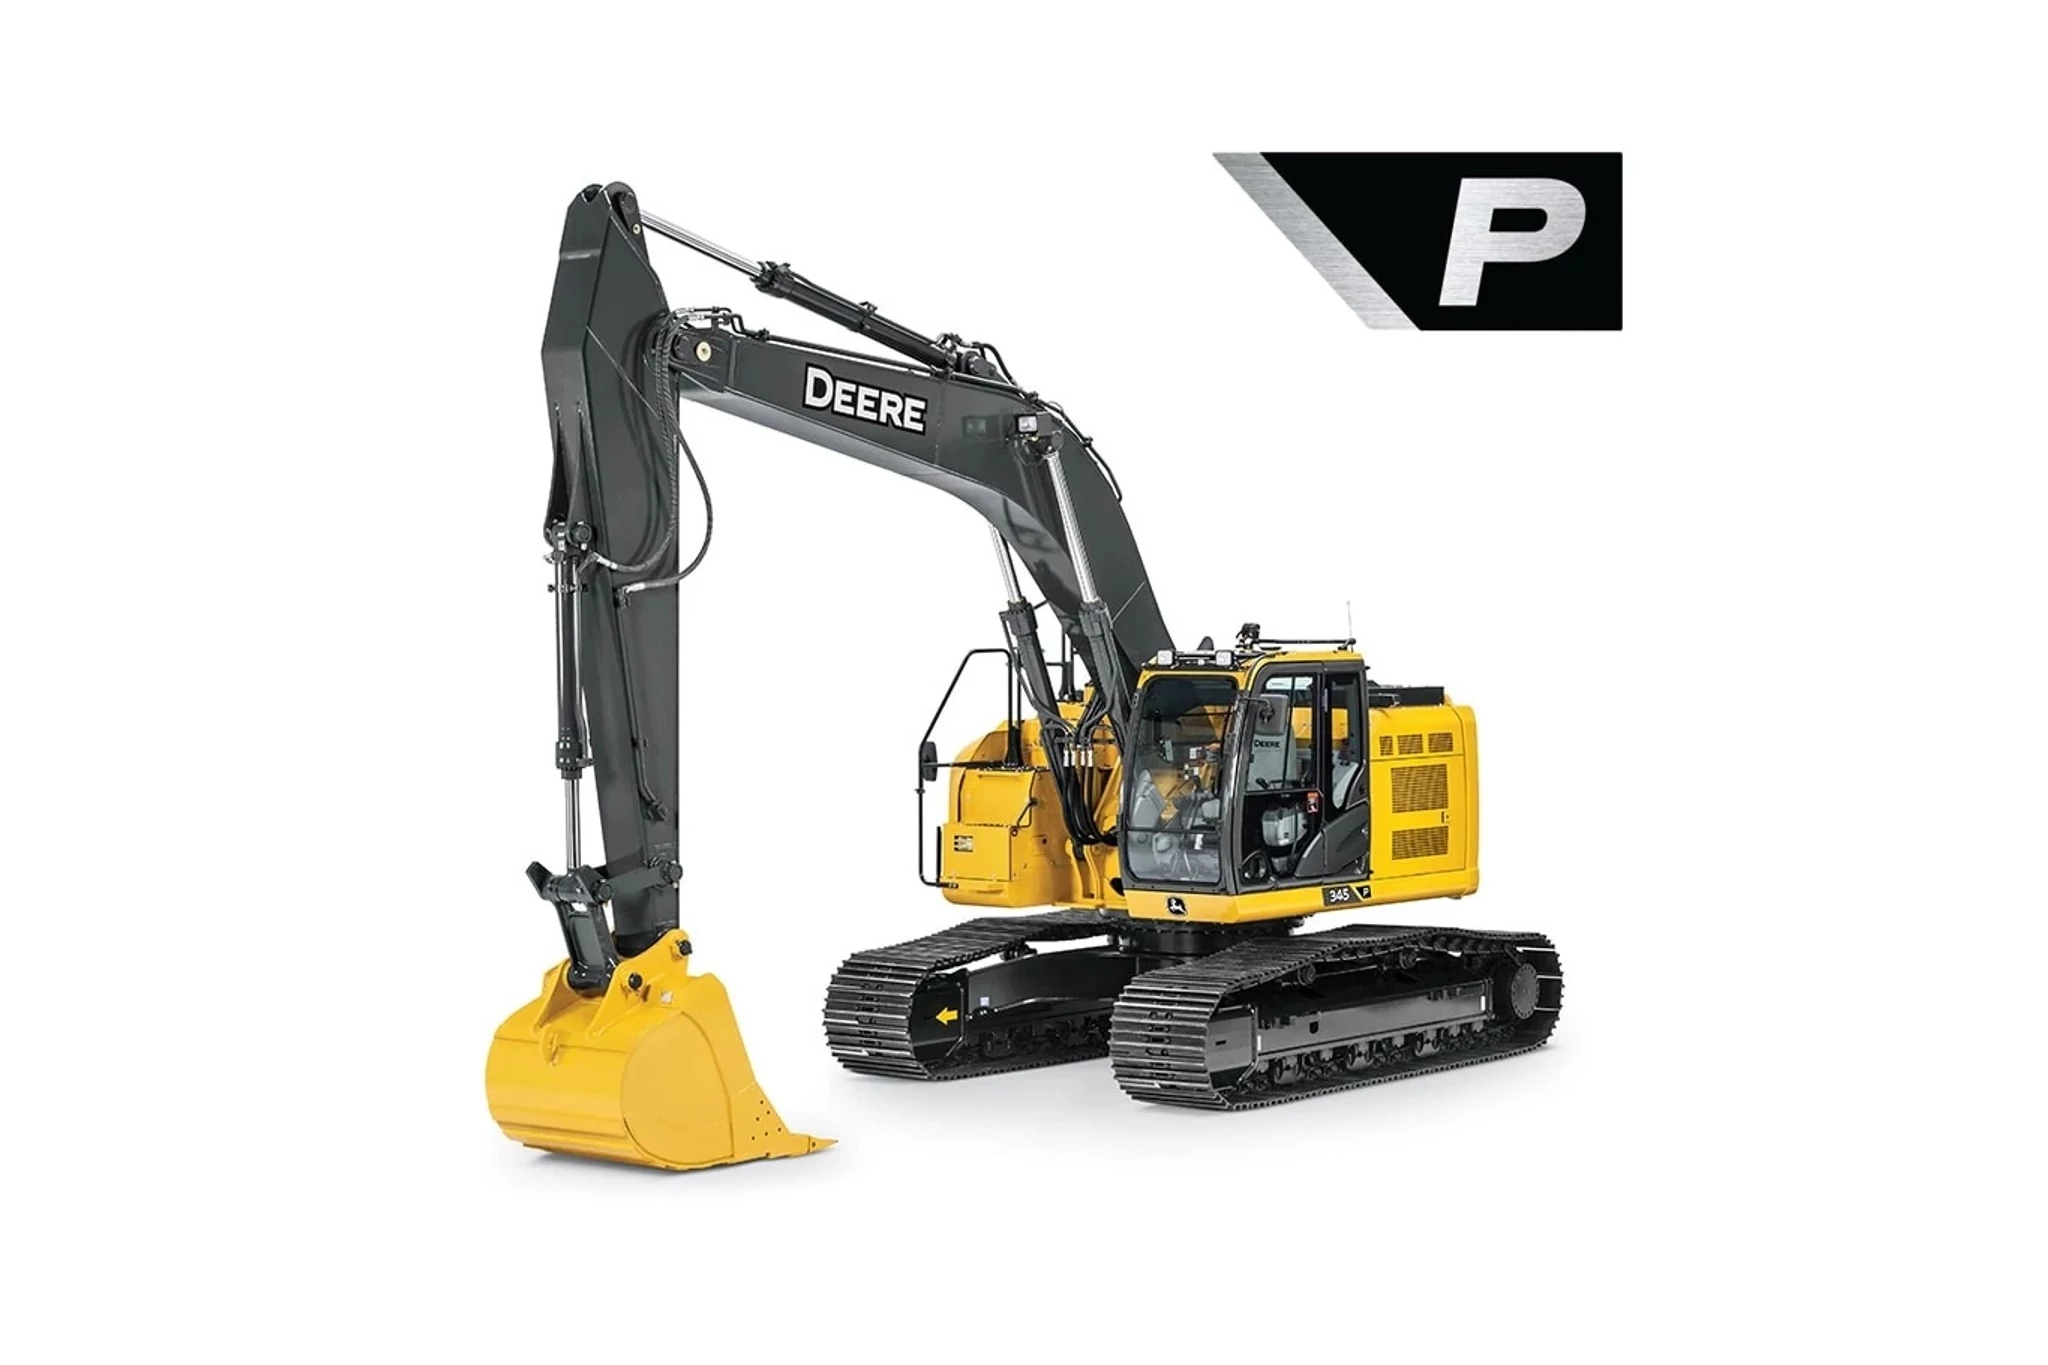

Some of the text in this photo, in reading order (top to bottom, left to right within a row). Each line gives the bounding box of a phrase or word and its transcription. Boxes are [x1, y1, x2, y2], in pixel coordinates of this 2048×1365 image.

[804, 365, 926, 432] DEERE
[1254, 739, 1280, 748] DEERE
[1329, 887, 1370, 903] 345 P
